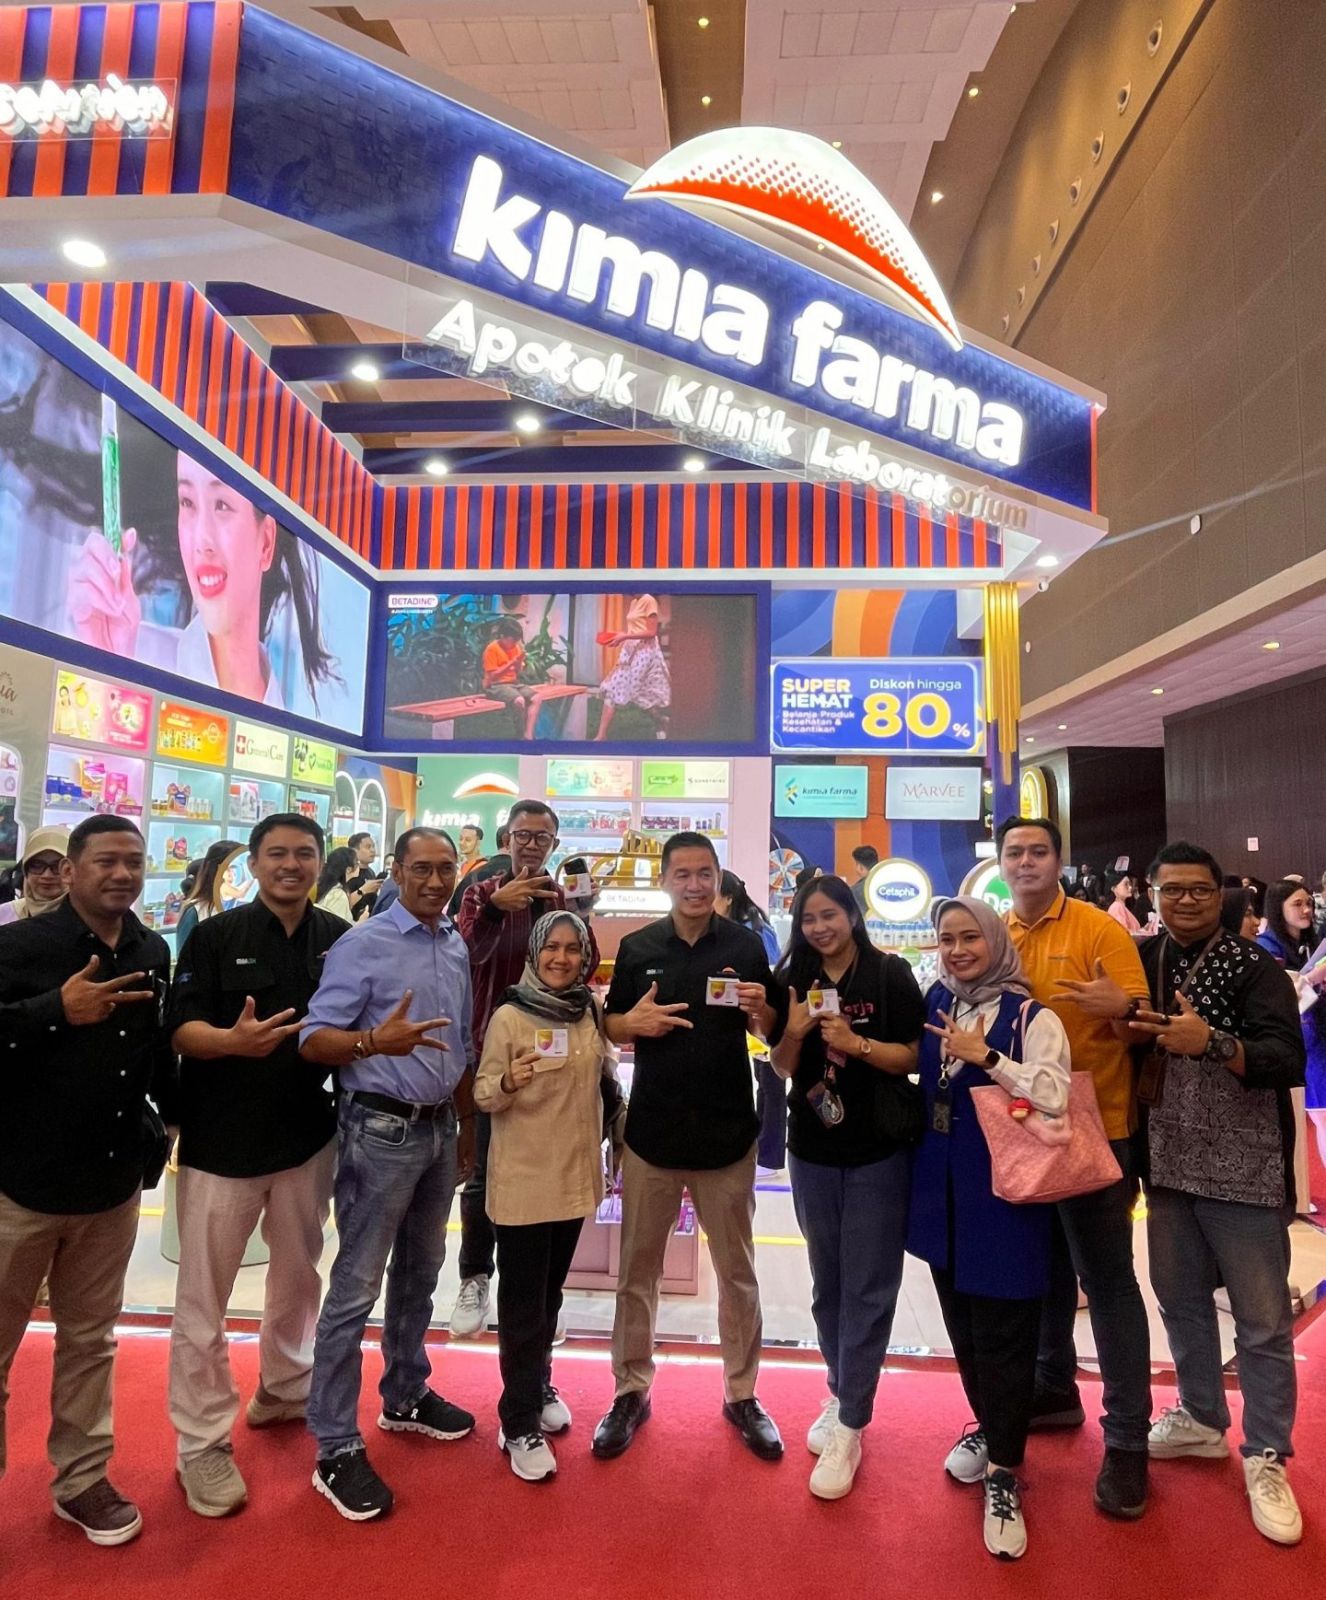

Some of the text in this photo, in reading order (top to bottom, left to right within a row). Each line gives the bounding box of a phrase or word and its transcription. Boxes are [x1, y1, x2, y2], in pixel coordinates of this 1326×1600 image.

[452, 154, 1023, 467] kimia farma
[426, 299, 1028, 530] Apotek Klinik Laboratorium
[782, 678, 850, 693] SUPER
[870, 679, 962, 691] Diskon hingga
[782, 694, 853, 708] HEMAT
[782, 710, 855, 719] Belanja Produk
[861, 692, 971, 738] 80 %
[782, 718, 842, 726] Kesehatan &
[829, 787, 858, 795] farma
[878, 885, 916, 897] Cetaphil
[983, 892, 1014, 917] De
